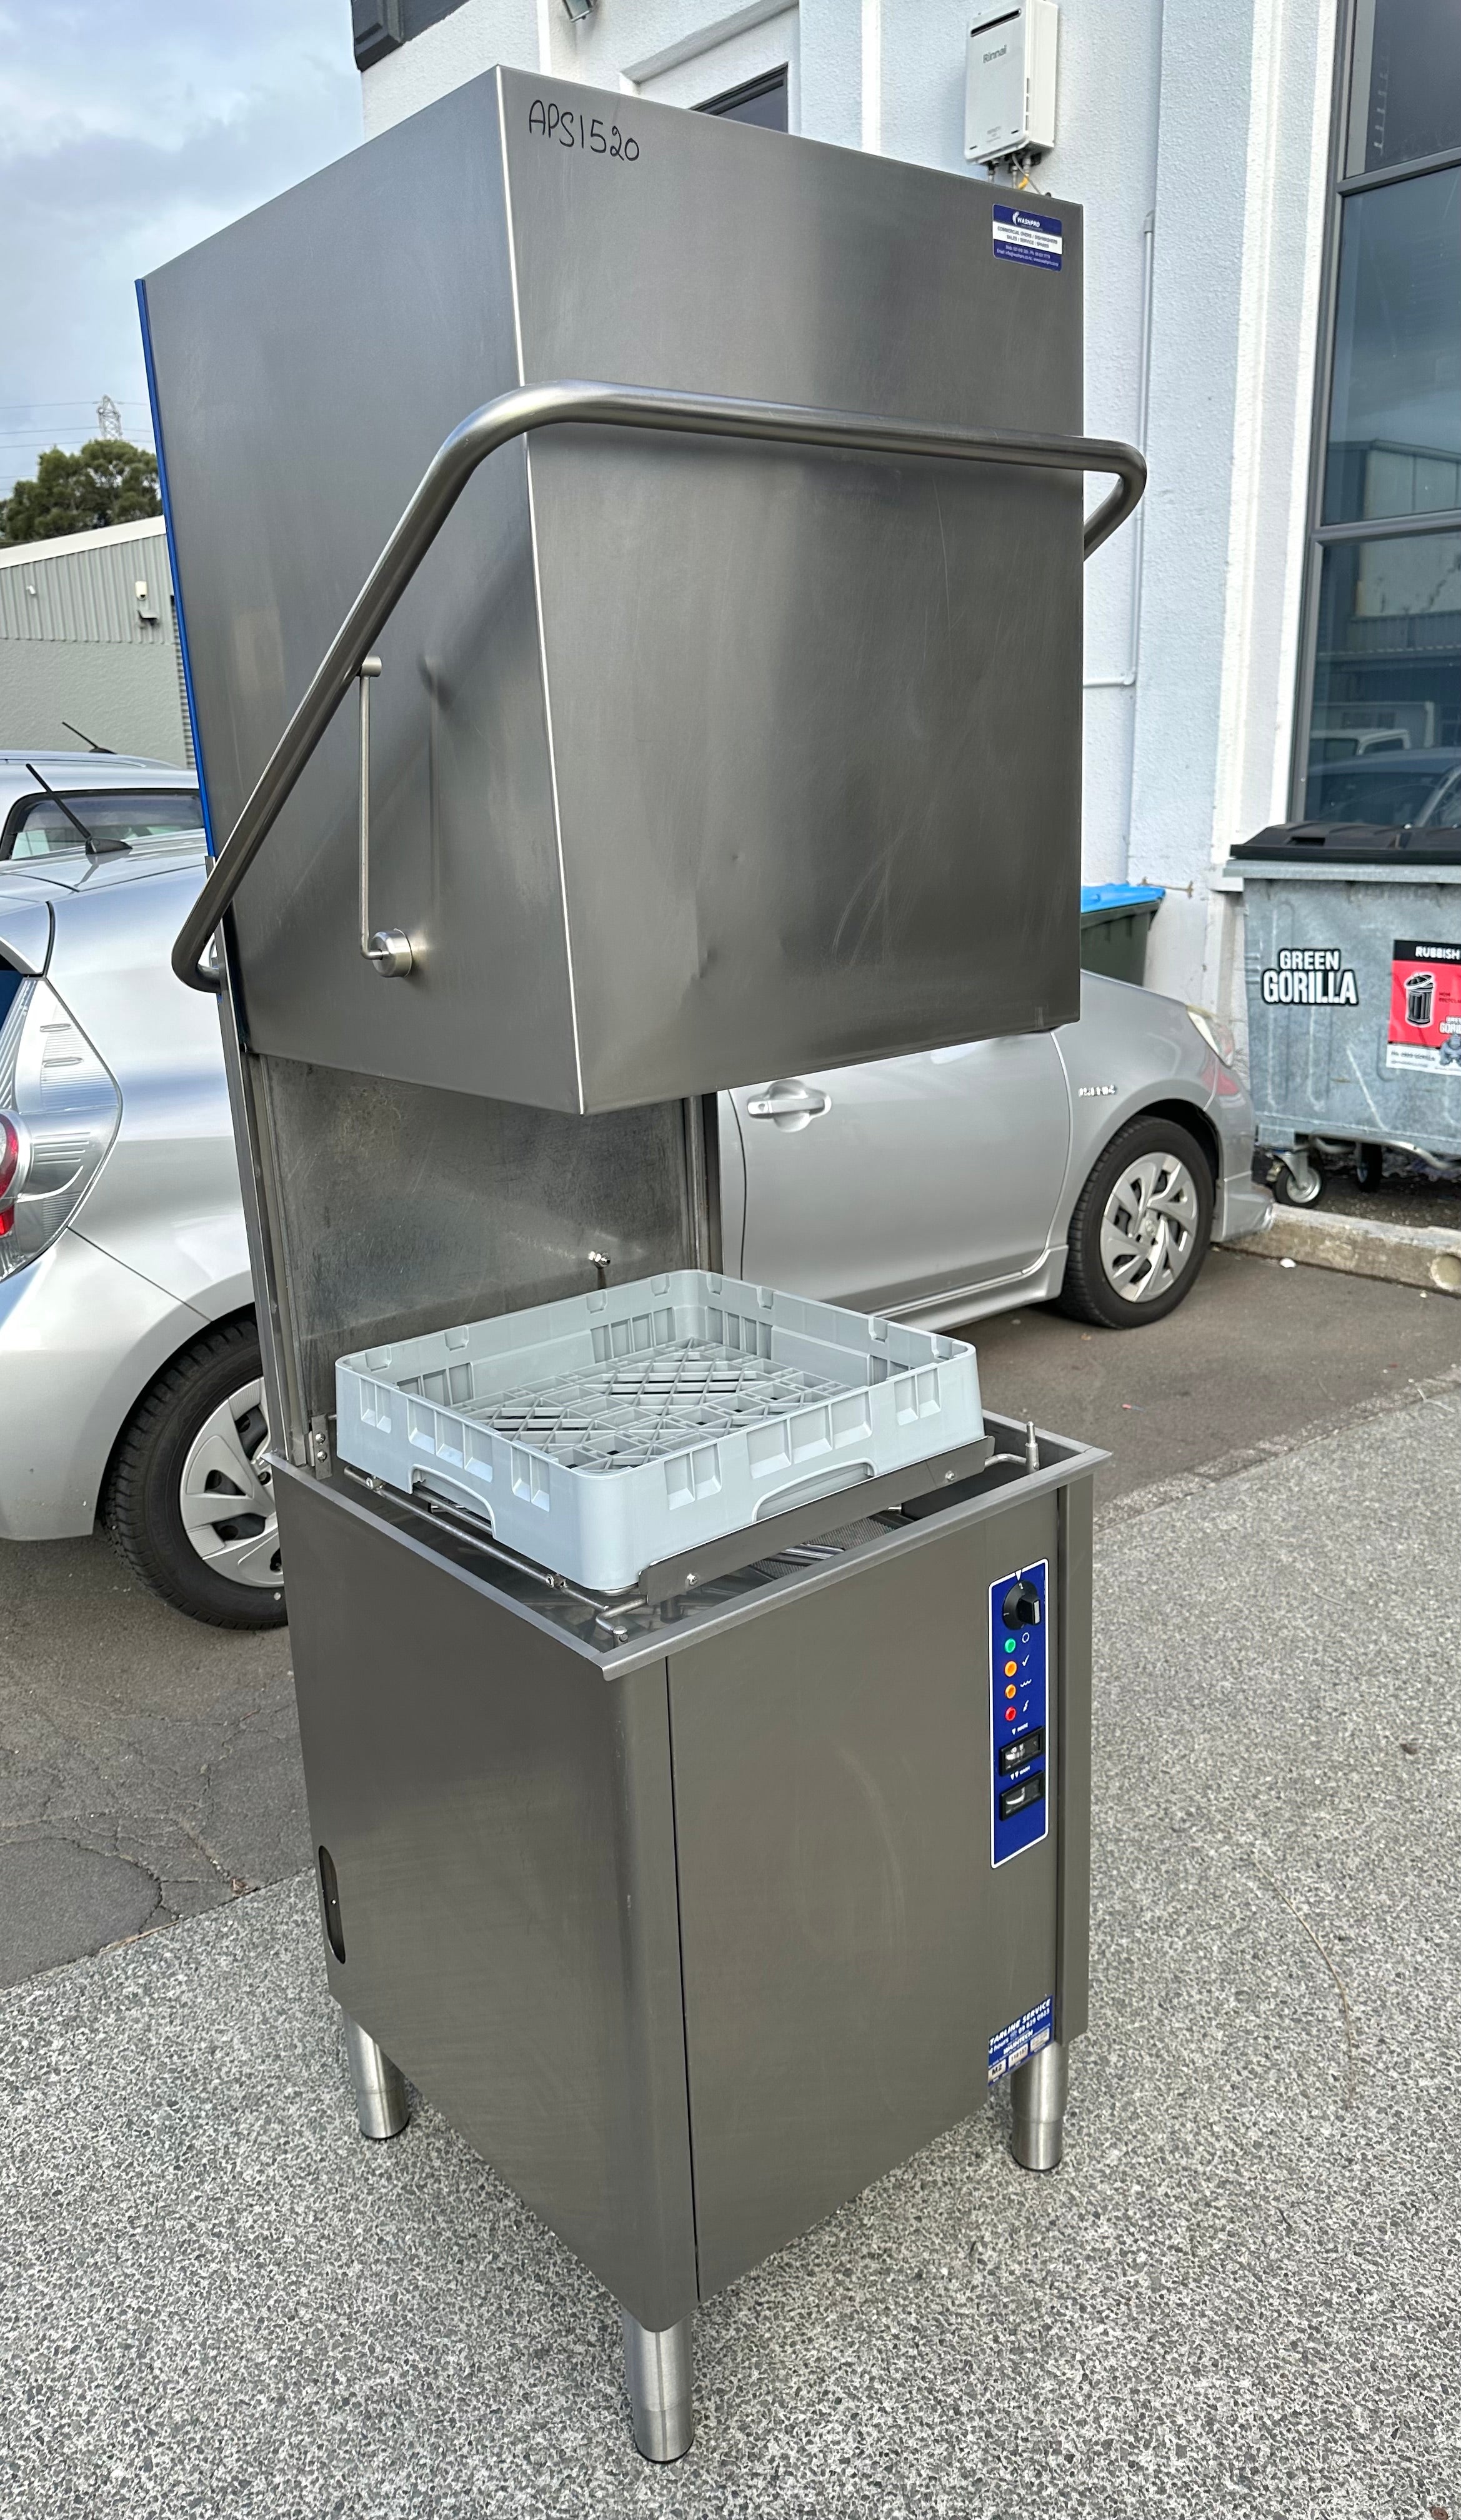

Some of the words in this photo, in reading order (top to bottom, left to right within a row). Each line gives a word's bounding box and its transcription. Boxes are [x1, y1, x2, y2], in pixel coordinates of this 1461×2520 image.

[983, 44, 1007, 63] Rinnai
[529, 100, 639, 161] APS1520
[1017, 217, 1040, 228] WASHPRO
[1281, 950, 1339, 969] GREEN
[1415, 946, 1460, 960] RUBBISH
[1263, 970, 1357, 1004] GORILLA
[1022, 1999, 1051, 2023] SERVICE
